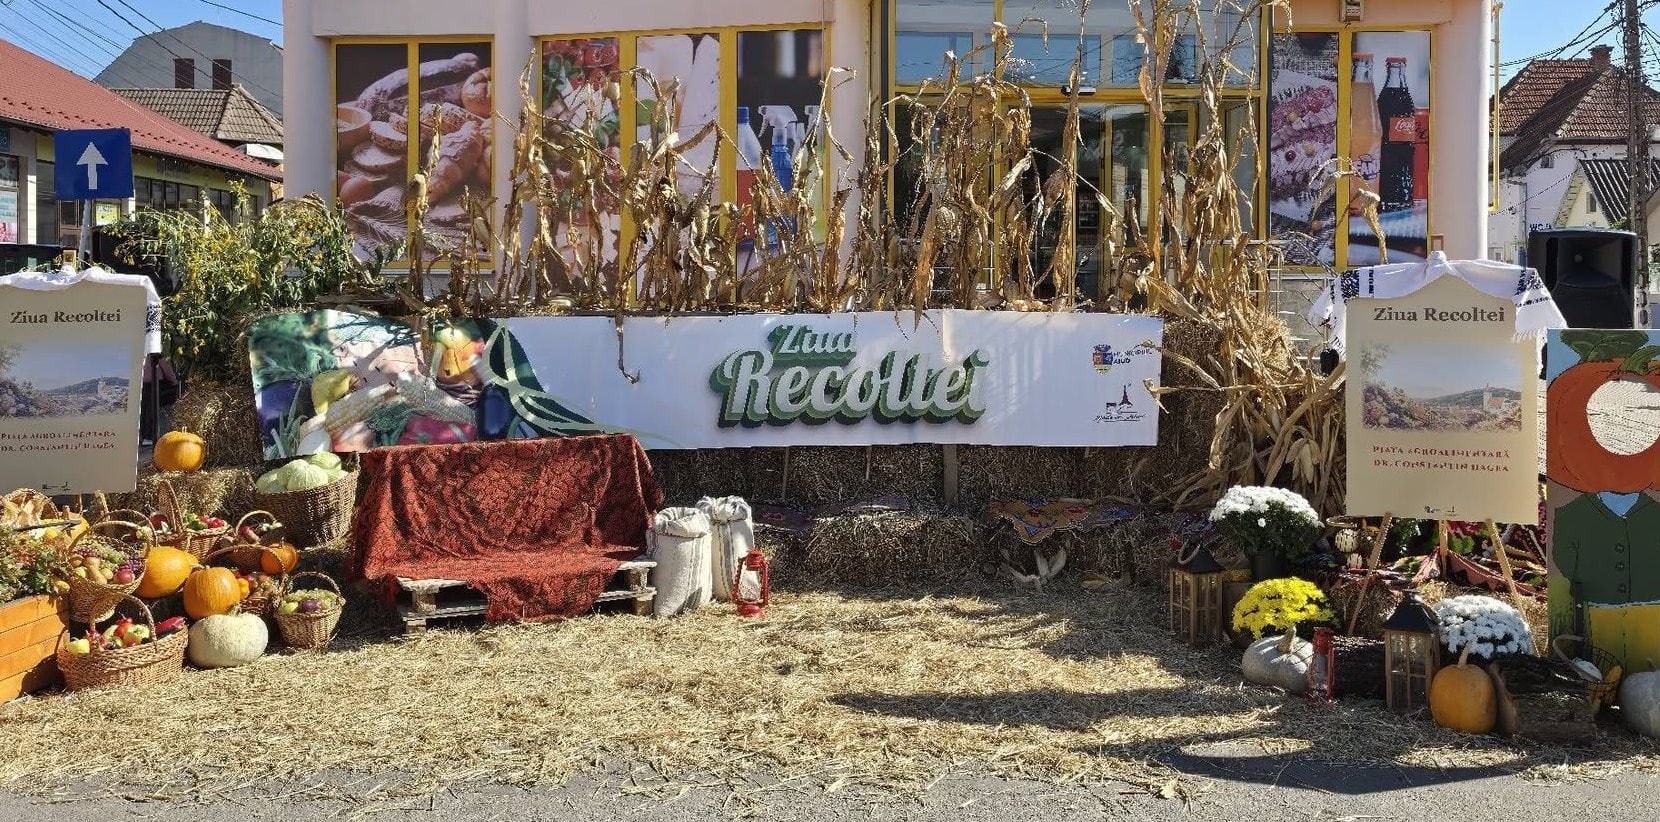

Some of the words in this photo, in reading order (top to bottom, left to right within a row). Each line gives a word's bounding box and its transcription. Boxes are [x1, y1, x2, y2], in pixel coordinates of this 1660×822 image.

[10, 310, 48, 324] Ziua
[54, 308, 121, 323] Recoltei
[1373, 305, 1417, 322] Ziua
[1423, 306, 1505, 322] Recoltei
[767, 324, 857, 360] Ziua
[709, 349, 990, 428] Recoltei
